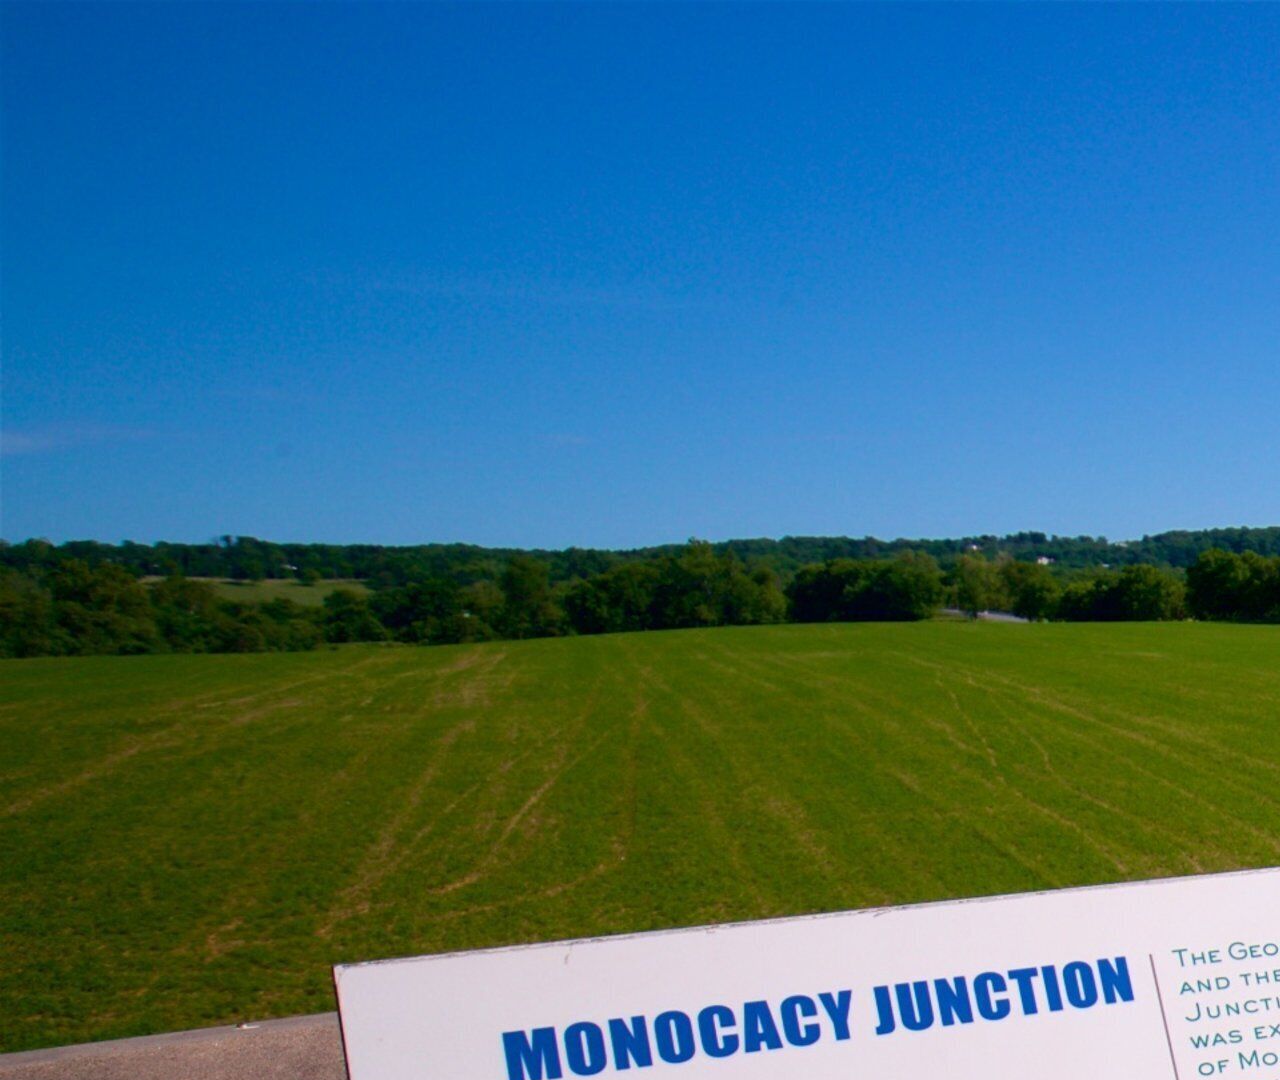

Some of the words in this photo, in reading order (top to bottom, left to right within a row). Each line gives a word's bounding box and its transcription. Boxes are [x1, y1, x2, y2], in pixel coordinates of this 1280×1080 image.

[1171, 948, 1222, 967] THE
[1180, 977, 1230, 995] AND
[873, 956, 1134, 1036] JUNCTION
[1190, 1030, 1243, 1049] WAS
[1198, 1059, 1229, 1076] OF
